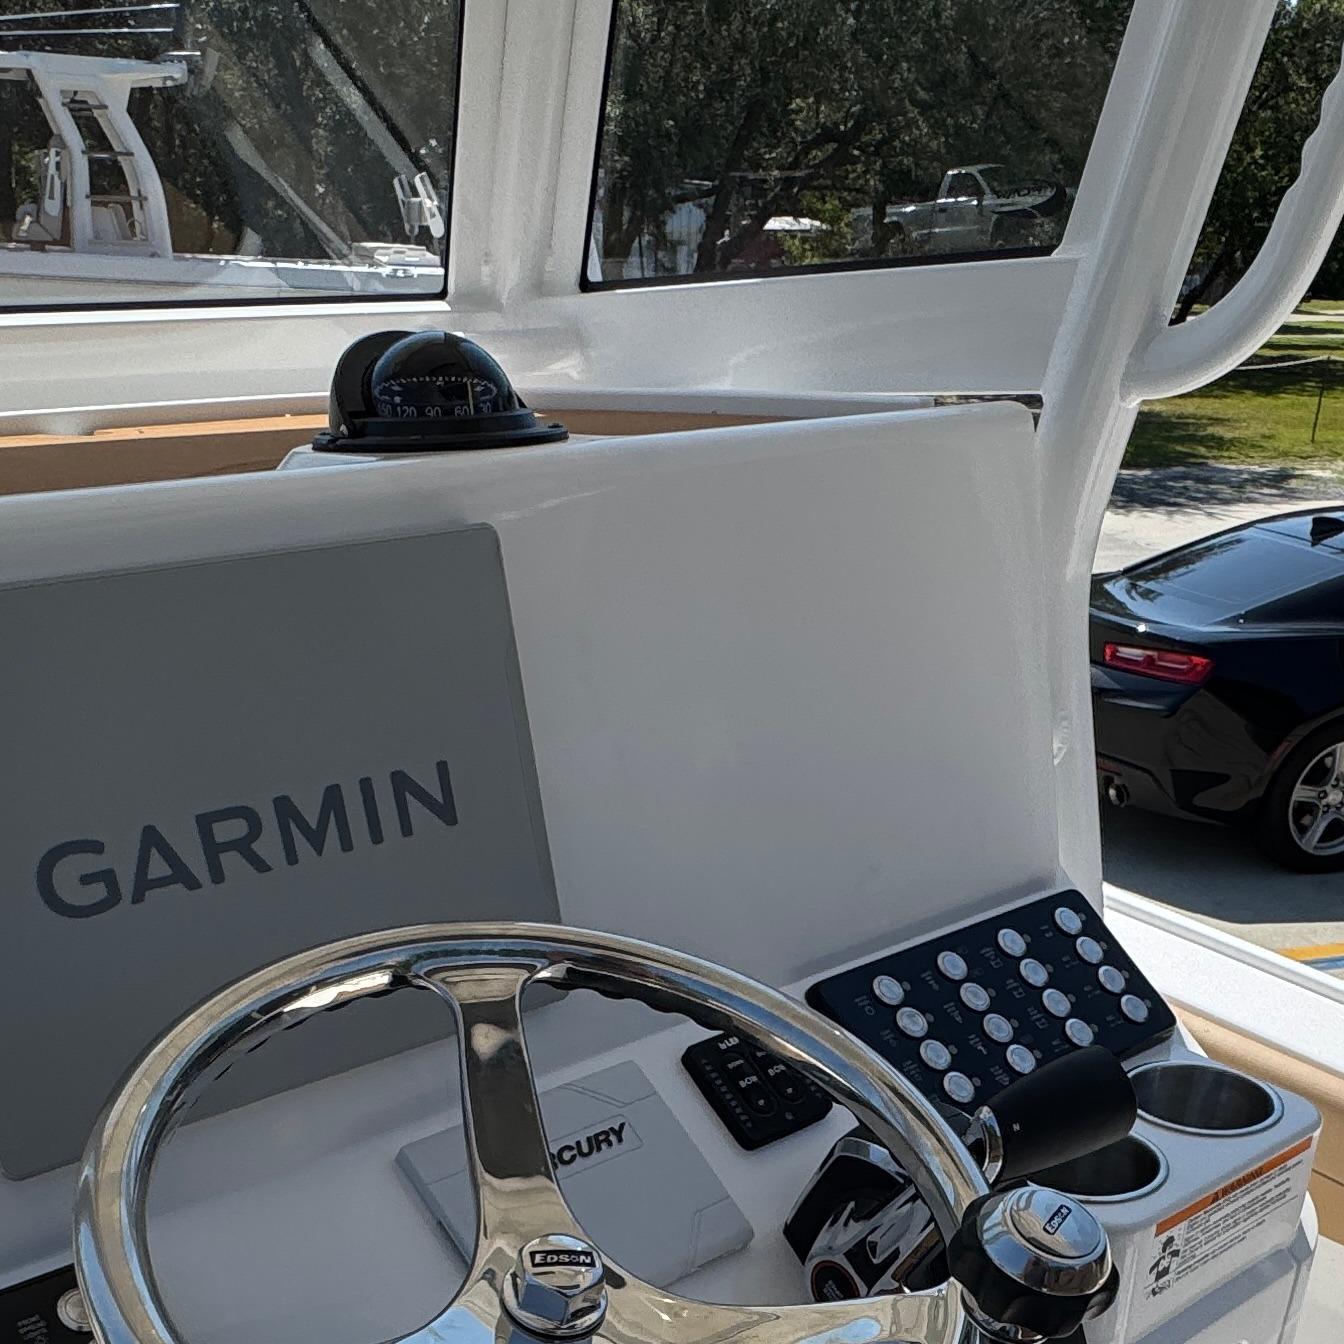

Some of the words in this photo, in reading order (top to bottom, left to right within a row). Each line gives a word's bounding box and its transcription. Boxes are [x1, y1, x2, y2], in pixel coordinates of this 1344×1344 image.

[424, 406, 443, 418] 90
[35, 759, 459, 920] GARMIN
[548, 1121, 628, 1170] CURY
[1044, 1205, 1071, 1234] EDSON
[533, 1251, 593, 1269] EDSON
